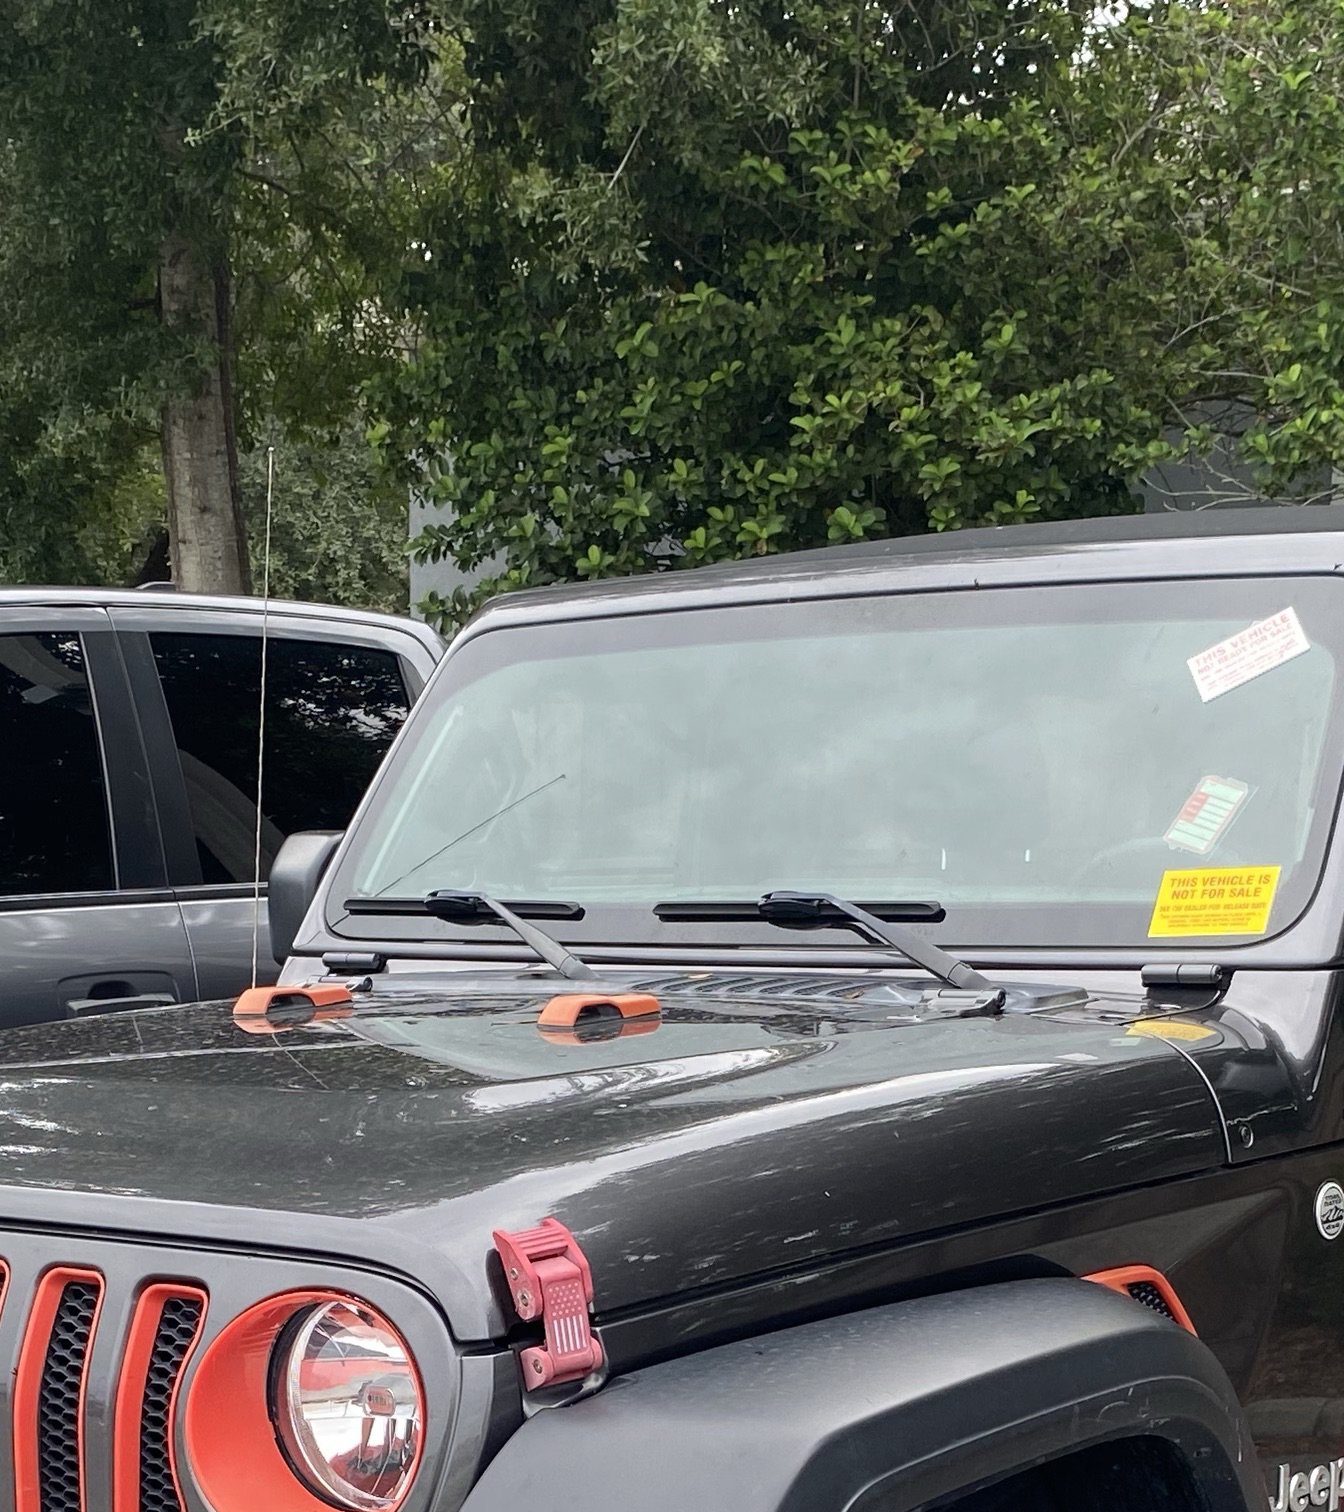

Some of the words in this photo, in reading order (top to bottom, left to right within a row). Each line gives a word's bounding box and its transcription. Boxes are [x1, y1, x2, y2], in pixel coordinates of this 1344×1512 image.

[1195, 646, 1226, 667] THIS
[1230, 613, 1291, 648] VEHICLE
[1197, 663, 1214, 675] NOT
[1250, 635, 1269, 649] FOR
[1270, 622, 1293, 638] SALE
[1170, 877, 1198, 889] THIS
[1202, 874, 1255, 887] VEHICLE
[1258, 874, 1272, 885] IS
[1171, 889, 1197, 900] NOT
[1200, 888, 1226, 899] FOR
[1228, 886, 1262, 898] SALE
